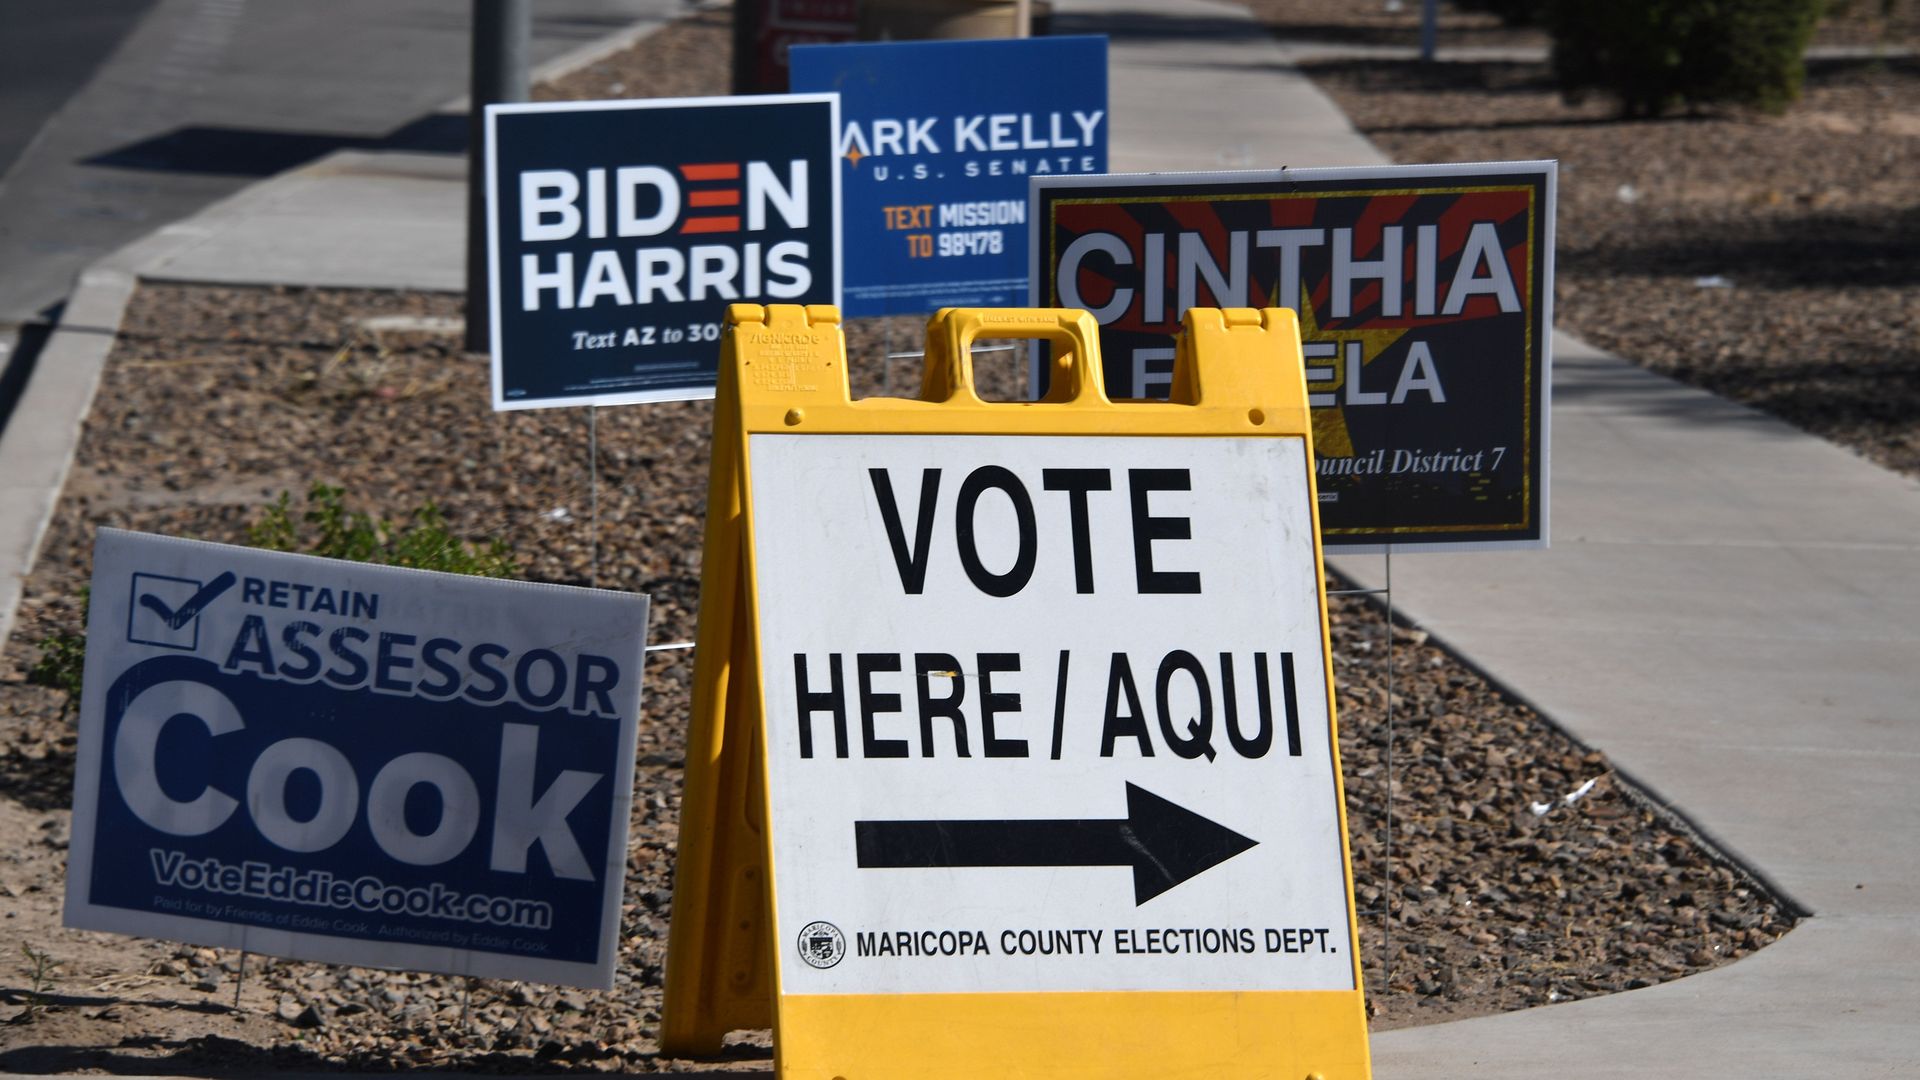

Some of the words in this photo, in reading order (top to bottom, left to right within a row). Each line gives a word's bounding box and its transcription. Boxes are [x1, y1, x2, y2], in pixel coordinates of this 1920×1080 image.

[841, 118, 942, 157] ARK
[954, 111, 1104, 152] KELLY
[873, 164, 945, 181] U.S.
[965, 156, 1095, 177] SENATE
[520, 159, 809, 242] BIDEN
[883, 205, 934, 230] TEXT
[939, 200, 1026, 228] MISSION
[907, 234, 933, 258] TO
[938, 230, 1004, 257] 98478
[521, 240, 812, 312] HARRIS
[1056, 223, 1521, 326] CINTHIA
[571, 331, 617, 350] Text
[623, 326, 657, 346] AZ
[662, 327, 684, 344] to
[686, 322, 723, 342] 30
[1132, 340, 1446, 406] EELA
[1316, 449, 1384, 475] uncil
[1390, 447, 1483, 474] District
[1490, 446, 1507, 471] 7
[868, 464, 1202, 598] VOTE
[242, 577, 379, 620] RETAIN
[224, 614, 621, 718] ASSESSOR
[793, 653, 1030, 759] HERE
[1100, 649, 1303, 764] AQUI
[113, 680, 605, 883] Cook
[150, 848, 553, 930] VoteEddieCook.com
[153, 896, 182, 911] Paid
[185, 901, 202, 913] for
[206, 903, 222, 918] by
[224, 905, 273, 924] Friends
[276, 914, 289, 925] of
[291, 914, 329, 930] Eddie
[378, 924, 449, 943] Authorized
[452, 930, 471, 946] by
[472, 933, 510, 948] Eddie
[856, 931, 990, 957] MARICOPA
[1000, 930, 1103, 956] COUNTY
[1114, 928, 1256, 955] ELECTIONS
[1265, 928, 1337, 954] DEPT.
